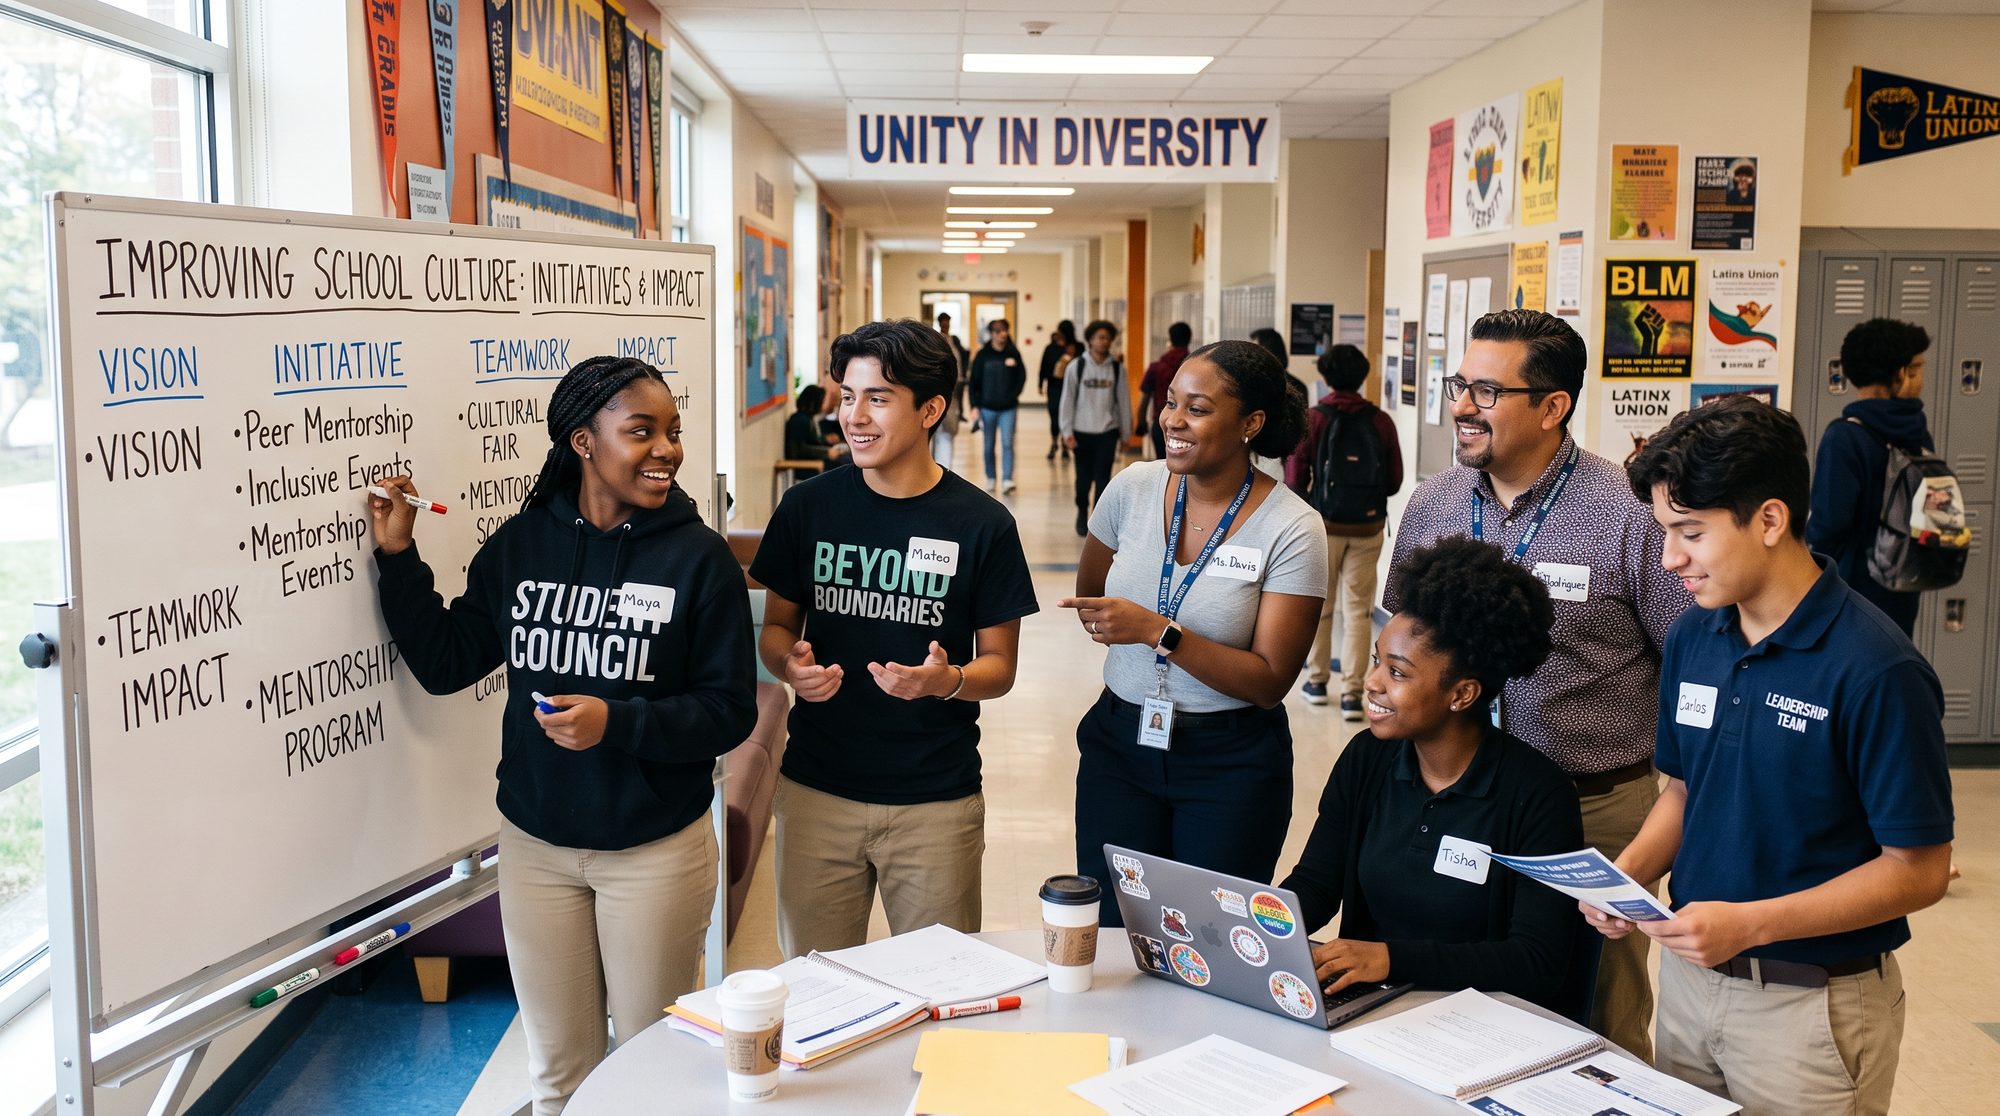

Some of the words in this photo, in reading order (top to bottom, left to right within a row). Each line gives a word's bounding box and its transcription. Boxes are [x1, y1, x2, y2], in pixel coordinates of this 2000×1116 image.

[1926, 90, 1999, 117] LATIN
[859, 114, 984, 165] UNITY
[998, 116, 1039, 166] IN
[1054, 116, 1268, 167] DIVERSITY
[1925, 118, 1999, 141] UNION
[96, 238, 294, 299] IMPROVING
[313, 246, 413, 300] SCHOOL
[425, 254, 525, 302] CULTURE:
[532, 261, 631, 307] INITIATIVES
[638, 270, 647, 305] &
[652, 269, 705, 308] IMPACT
[1611, 265, 1690, 296] BLM
[1748, 269, 1779, 279] Union
[98, 346, 199, 394] VISION
[274, 341, 404, 383] INITIATIVE
[470, 338, 572, 374] TEAMWORK
[617, 336, 677, 366] IMPACT
[467, 398, 544, 430] CULTURAL
[1612, 389, 1671, 402] LATINX
[1615, 404, 1668, 416] UNION
[243, 410, 295, 451] Peer
[303, 403, 413, 444] Mentorship
[97, 425, 202, 482] VISION
[483, 432, 520, 464] FAIR
[248, 466, 340, 507] Inclusive
[348, 451, 413, 491] Events
[251, 510, 366, 561] Mentorship
[281, 552, 354, 597] Events
[814, 541, 951, 598] BEYOND
[911, 548, 950, 564] Mateo
[1209, 556, 1228, 567] Ms.
[1229, 555, 1257, 572] Davis
[108, 585, 242, 658] TEAMWORK
[511, 580, 664, 635] STUDE
[623, 594, 661, 611] Maya
[814, 584, 945, 627] BOUNDARIES
[510, 625, 655, 682] COUNCIL
[121, 652, 229, 732] IMPACT
[259, 640, 400, 724] MENTORSHIP
[1679, 694, 1707, 715] Carlos
[1765, 692, 1829, 721] LEADERSHIP
[1777, 712, 1807, 733] TEAM
[285, 700, 384, 777] PROGRAM
[1442, 848, 1478, 871] Tisha
